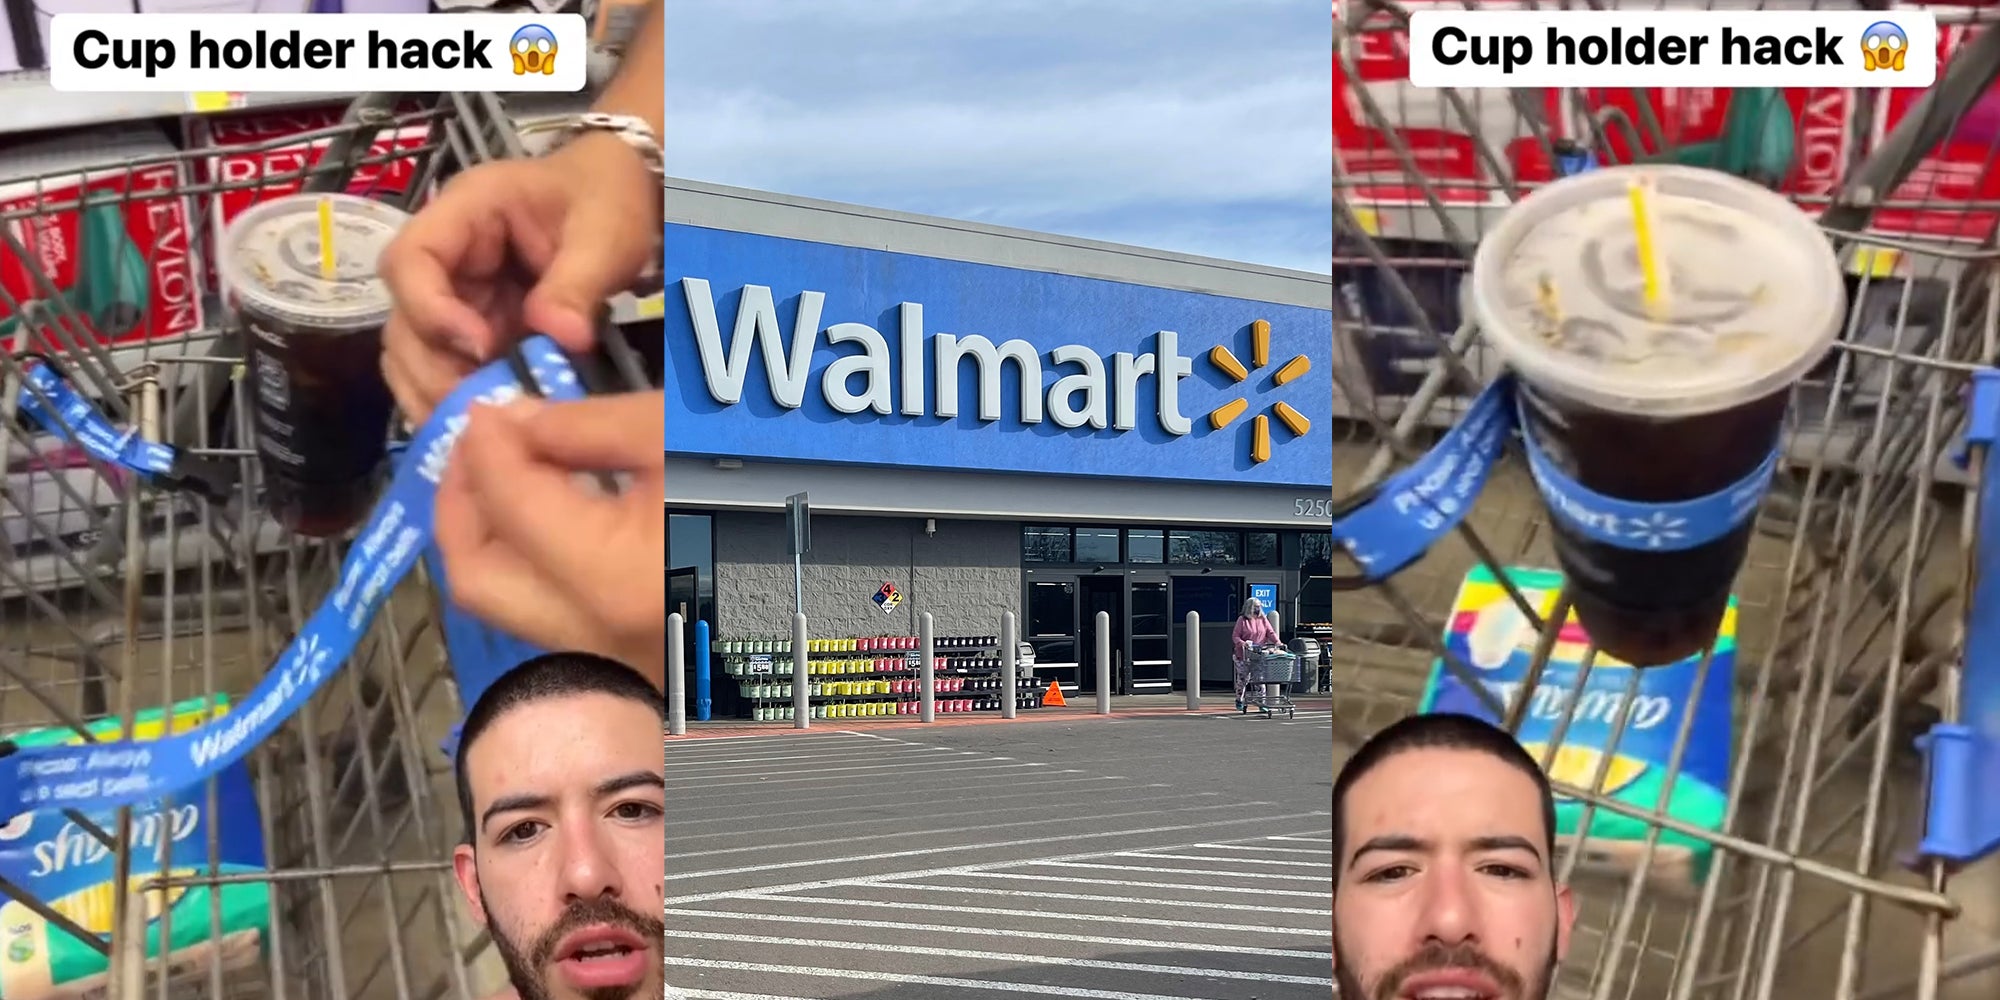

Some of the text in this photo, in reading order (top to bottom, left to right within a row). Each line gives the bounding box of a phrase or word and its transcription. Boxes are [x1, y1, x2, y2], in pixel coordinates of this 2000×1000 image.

[681, 276, 1193, 436] Walmart
[883, 584, 892, 594] 4
[1255, 589, 1271, 597] EXIT
[892, 592, 900, 602] 2
[1260, 599, 1273, 608] NLY
[190, 669, 296, 768] Walmart
